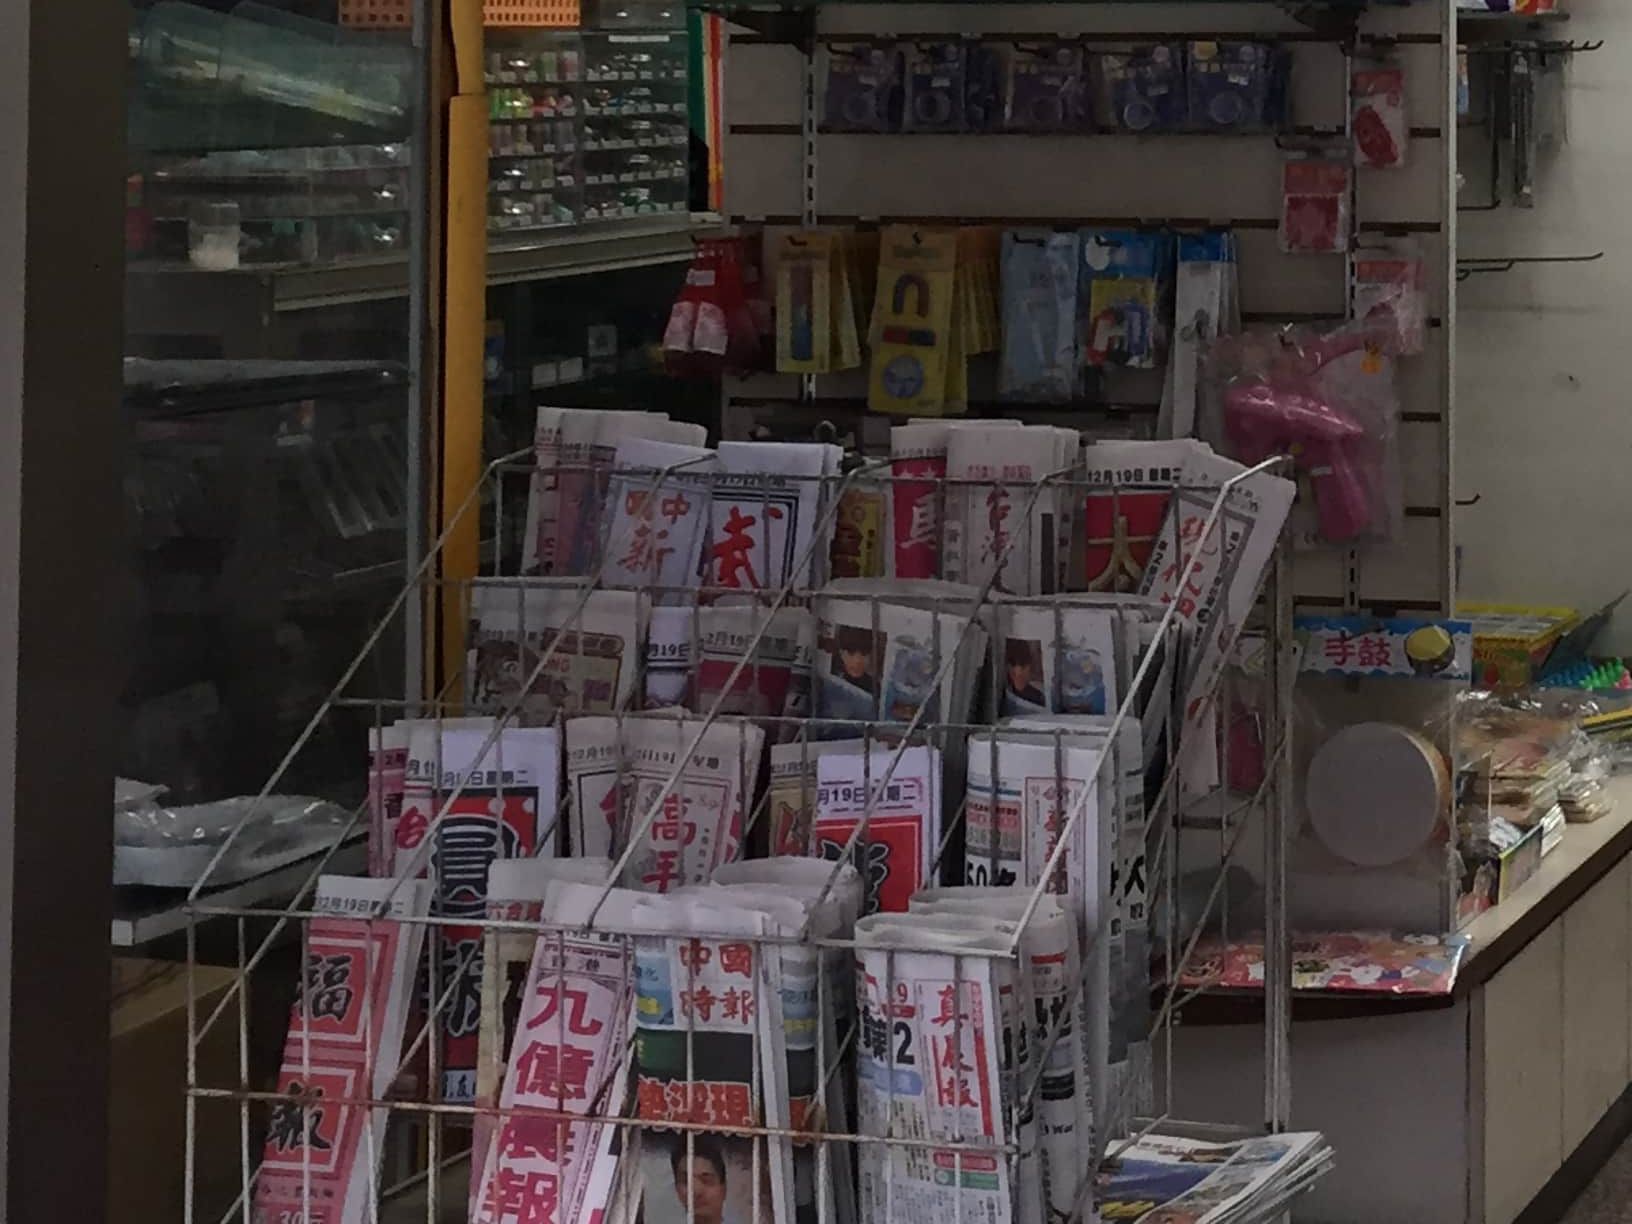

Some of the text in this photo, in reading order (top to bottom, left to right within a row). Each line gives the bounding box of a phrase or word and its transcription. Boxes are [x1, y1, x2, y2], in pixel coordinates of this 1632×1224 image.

[1323, 634, 1392, 667] 手鼓
[679, 939, 753, 978] 中國
[679, 988, 755, 1025] 時報
